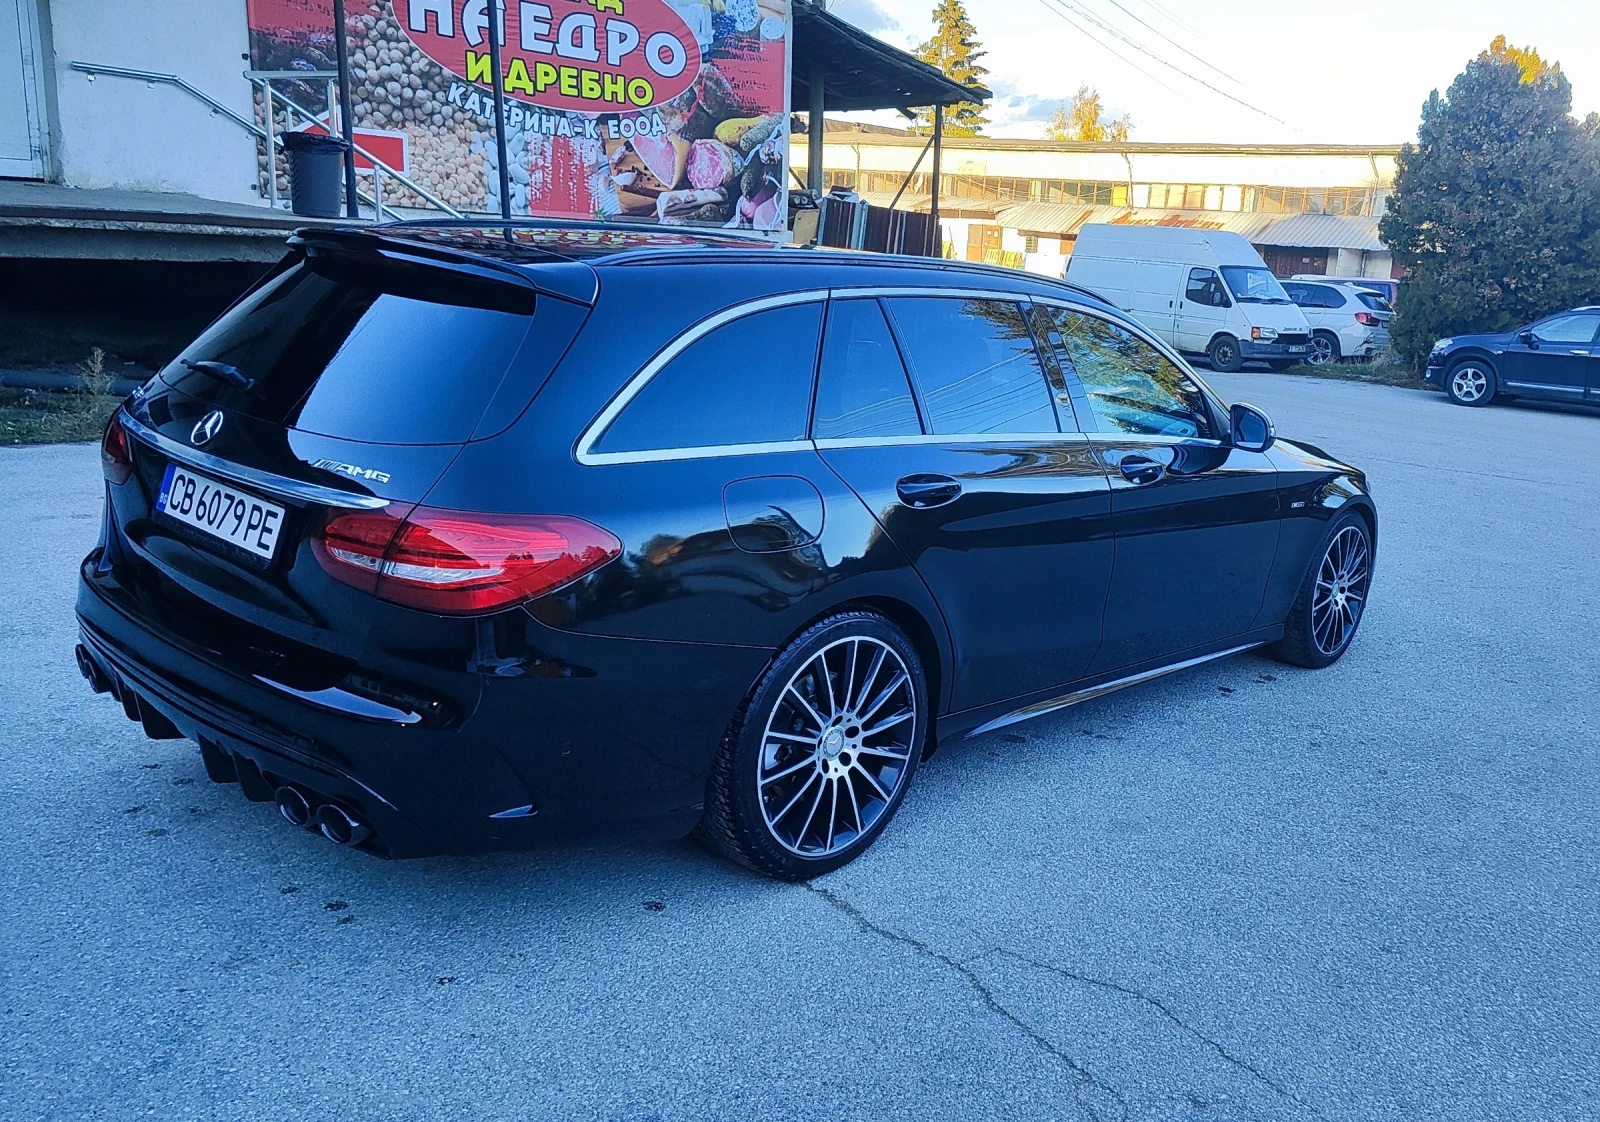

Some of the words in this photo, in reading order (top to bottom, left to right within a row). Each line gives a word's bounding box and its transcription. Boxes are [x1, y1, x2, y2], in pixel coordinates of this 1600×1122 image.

[465, 50, 494, 84] И
[503, 57, 654, 107] ДРЕБНО
[607, 112, 667, 139] ЕООД
[334, 462, 391, 484] AMG
